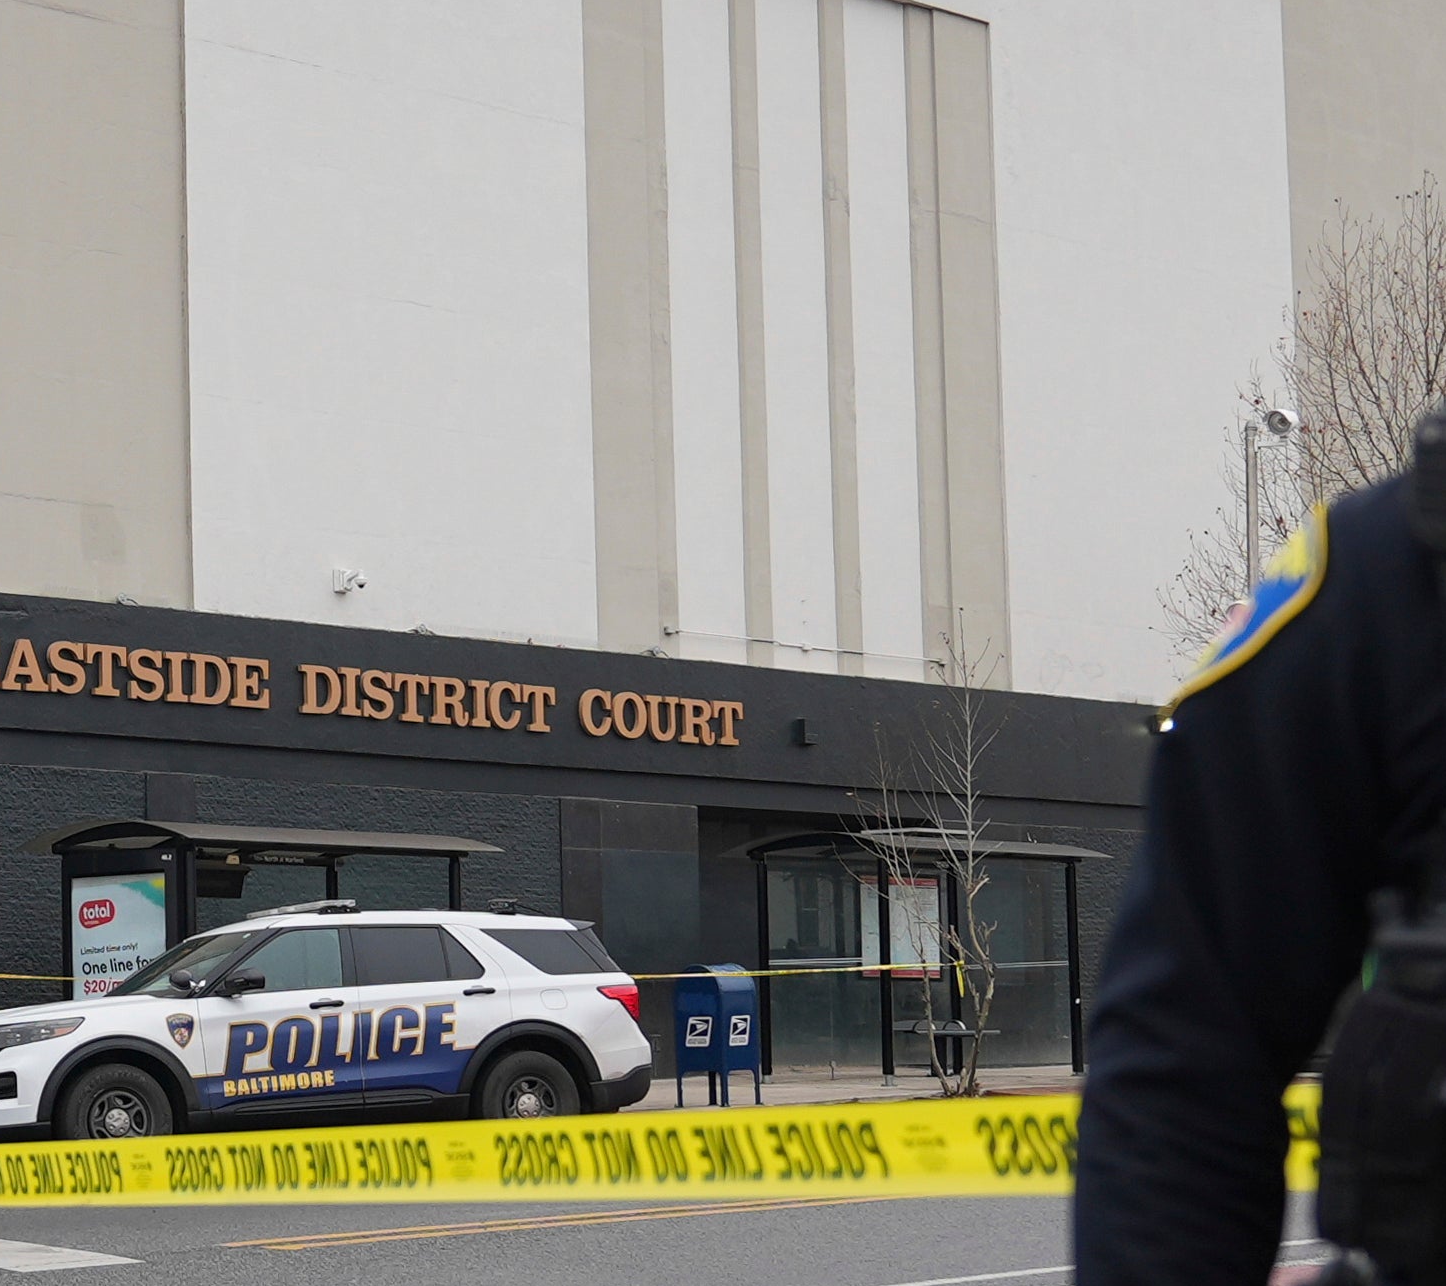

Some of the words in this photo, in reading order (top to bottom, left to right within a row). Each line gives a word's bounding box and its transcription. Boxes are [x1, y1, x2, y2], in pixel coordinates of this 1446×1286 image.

[298, 663, 556, 733] DISTRICT
[578, 686, 745, 747] COURT
[82, 901, 111, 920] total
[80, 945, 105, 956] Limited
[106, 943, 121, 953] time
[122, 942, 138, 954] only!
[82, 961, 107, 976] One
[109, 958, 133, 973] line
[225, 1000, 457, 1075] POLICE
[223, 1069, 335, 1098] BALTIMORE
